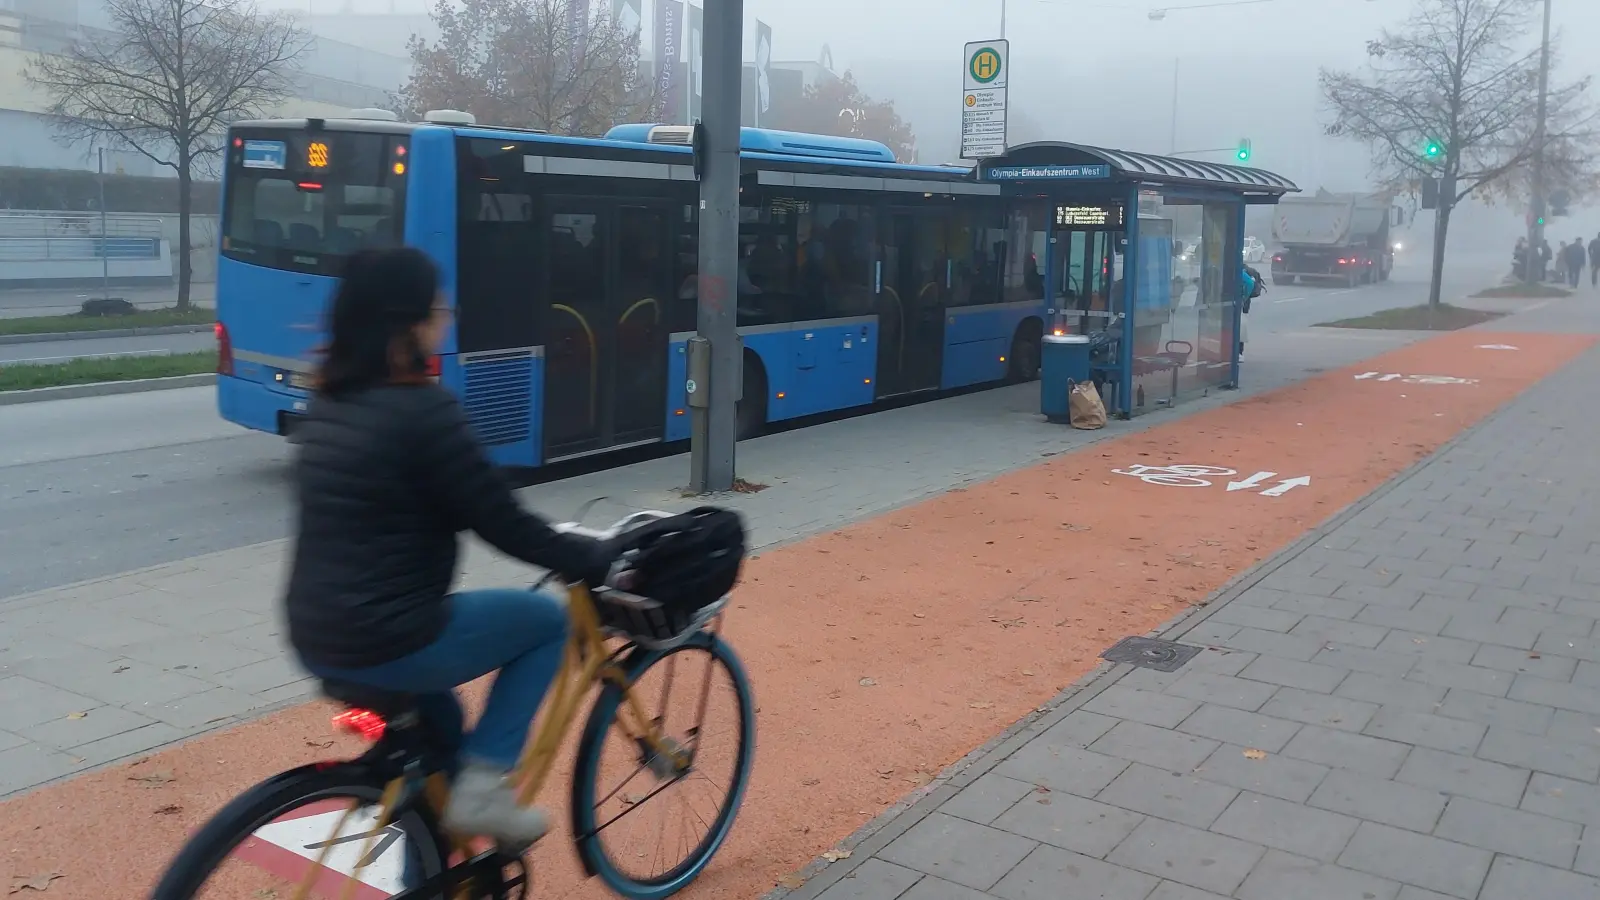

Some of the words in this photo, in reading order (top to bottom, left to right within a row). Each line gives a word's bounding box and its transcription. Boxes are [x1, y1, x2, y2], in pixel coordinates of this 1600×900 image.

[978, 55, 992, 75] H
[967, 97, 973, 105] 3
[991, 168, 1079, 178] Olympia-Einkaufszentrum
[1081, 167, 1100, 176] West
